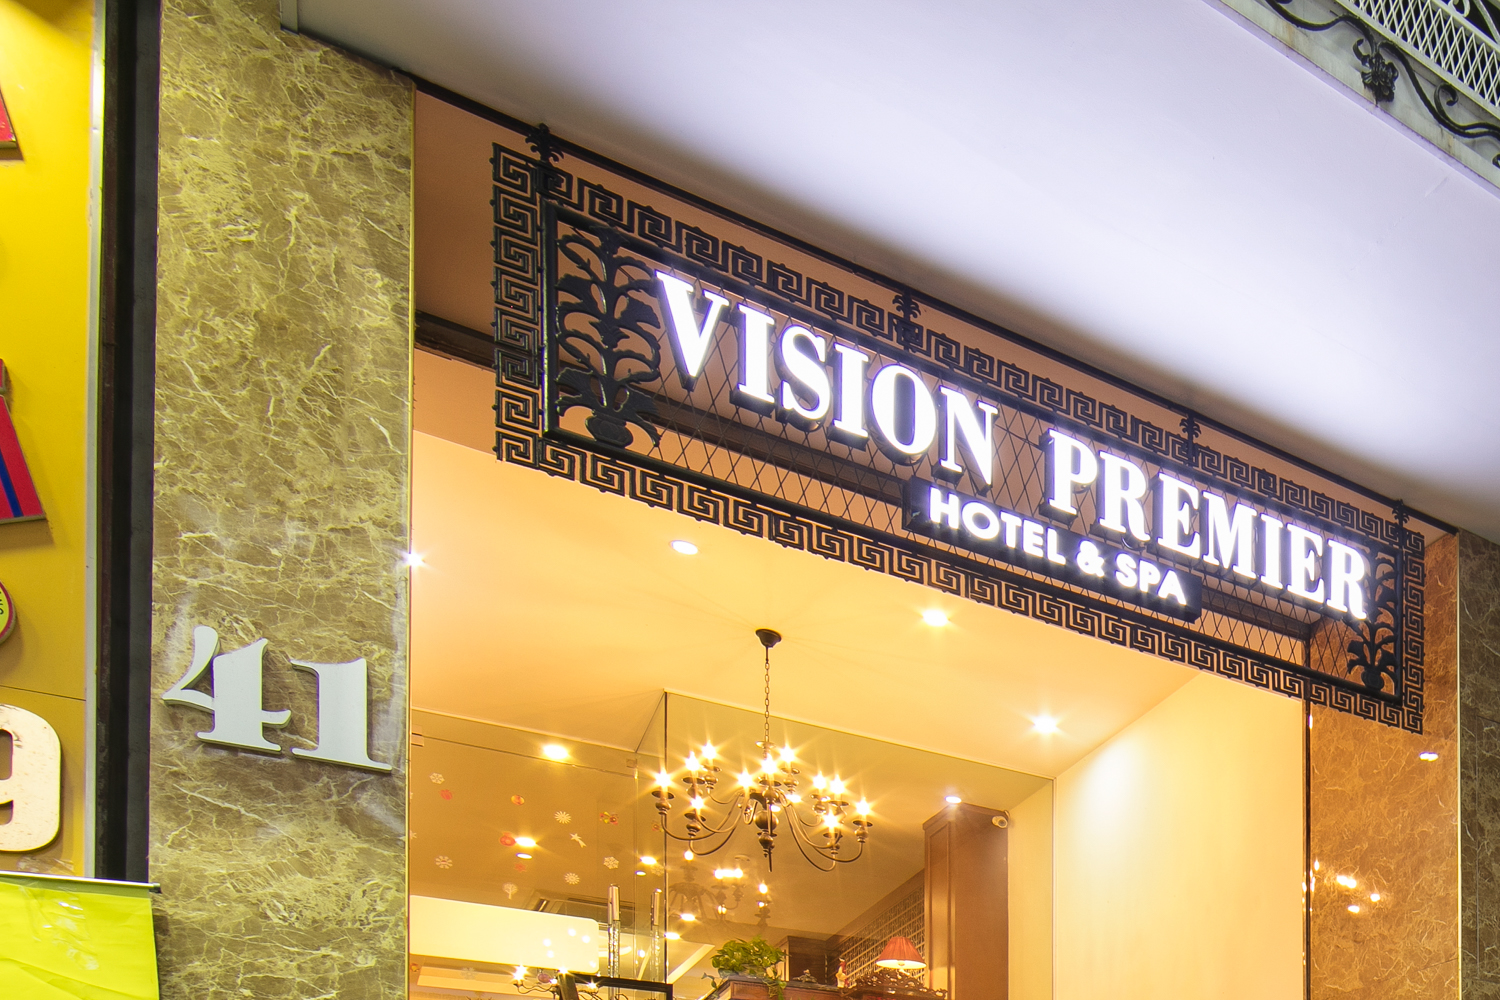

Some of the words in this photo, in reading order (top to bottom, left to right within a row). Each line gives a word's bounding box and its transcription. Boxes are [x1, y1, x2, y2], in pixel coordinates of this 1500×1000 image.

[654, 267, 998, 489] VISION
[1046, 427, 1369, 621] PREMIER
[927, 485, 1066, 565] HOTEL
[1077, 539, 1105, 578] &
[1113, 552, 1189, 608] SPA
[162, 625, 392, 772] 41
